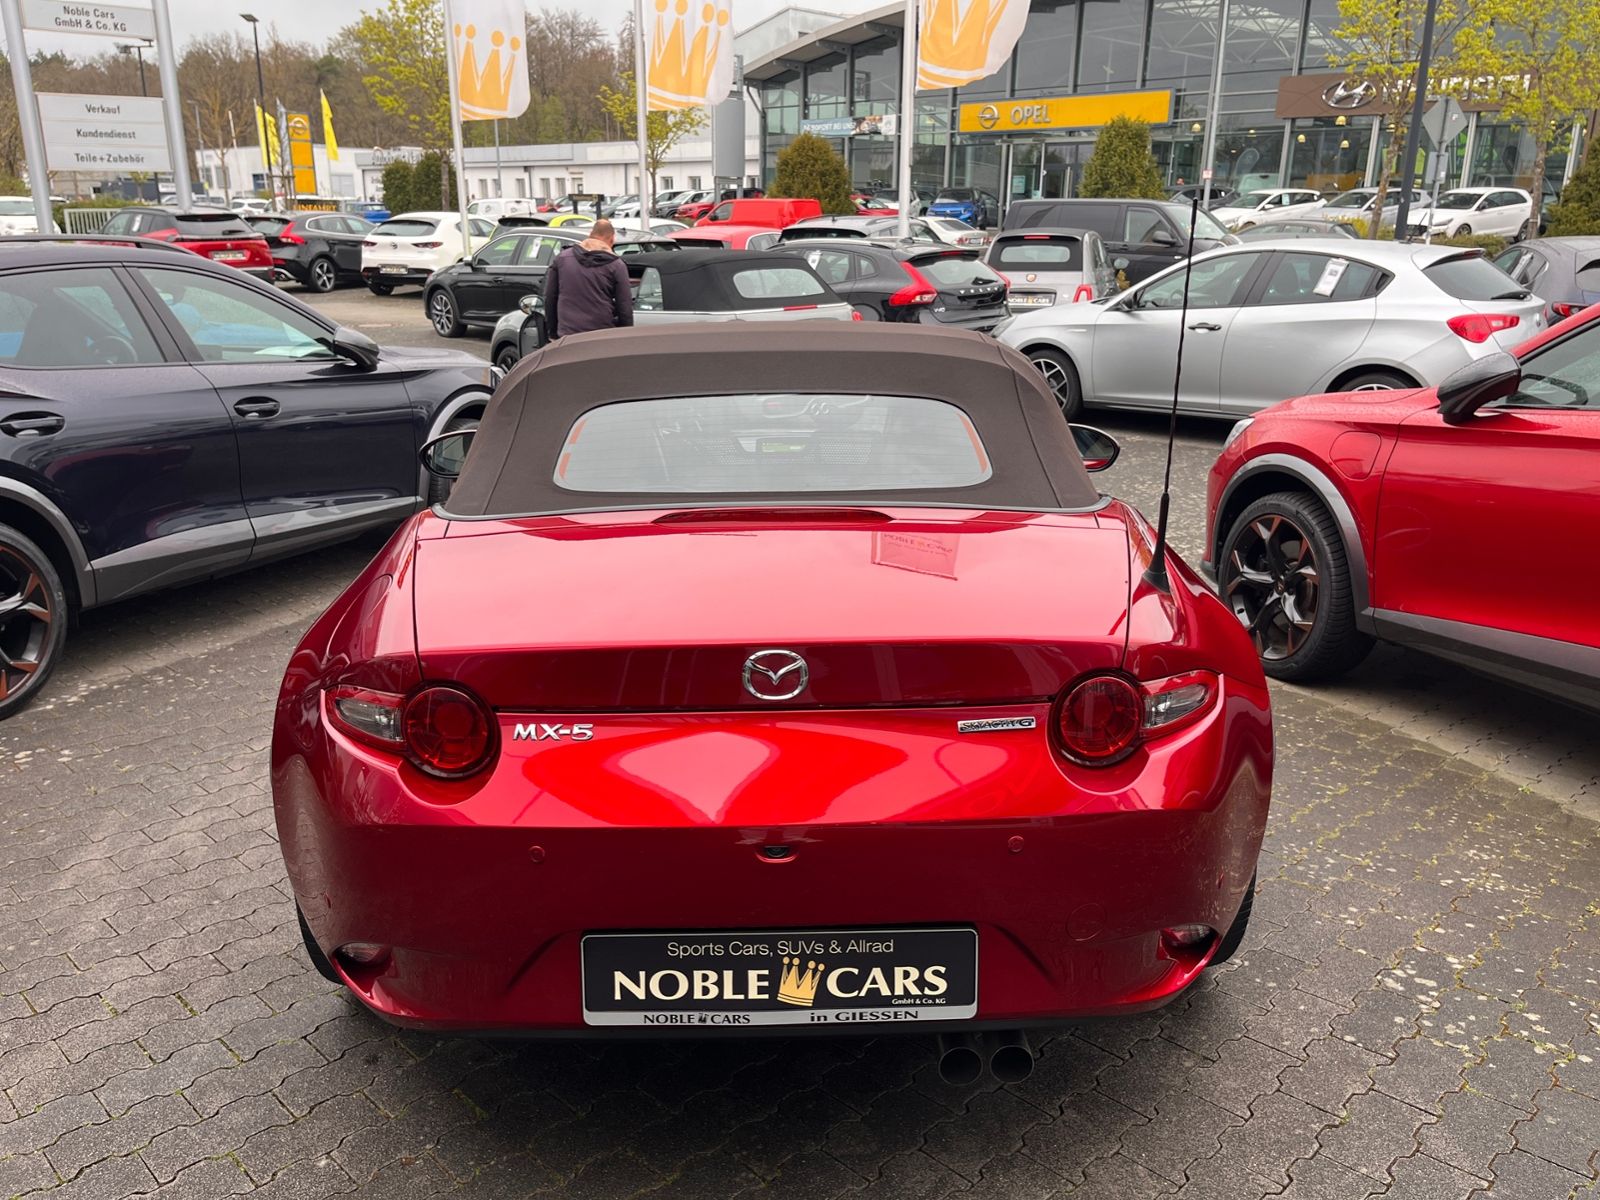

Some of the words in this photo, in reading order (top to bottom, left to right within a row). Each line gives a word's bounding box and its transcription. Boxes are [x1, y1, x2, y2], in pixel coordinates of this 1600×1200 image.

[63, 6, 90, 17] Noble
[93, 8, 115, 19] Cars
[55, 17, 82, 29] GmbH
[86, 20, 92, 29] &
[96, 21, 111, 31] Co.
[113, 23, 127, 32] KG
[85, 104, 120, 115] Verkauf
[1011, 105, 1051, 125] OPEL
[76, 128, 136, 140] Kundendienst
[513, 723, 593, 741] MX-5
[667, 941, 725, 959] Sports
[729, 941, 773, 957] Cars,
[777, 940, 825, 955] SUVs
[829, 940, 842, 954] &
[846, 939, 894, 953] Allrad
[614, 969, 770, 1001] NOBLE
[826, 966, 948, 998] CARS
[643, 1014, 695, 1024] NOBLE
[710, 1013, 751, 1025] CARS
[810, 1012, 828, 1022] in
[835, 1010, 919, 1022] GIESSEN
